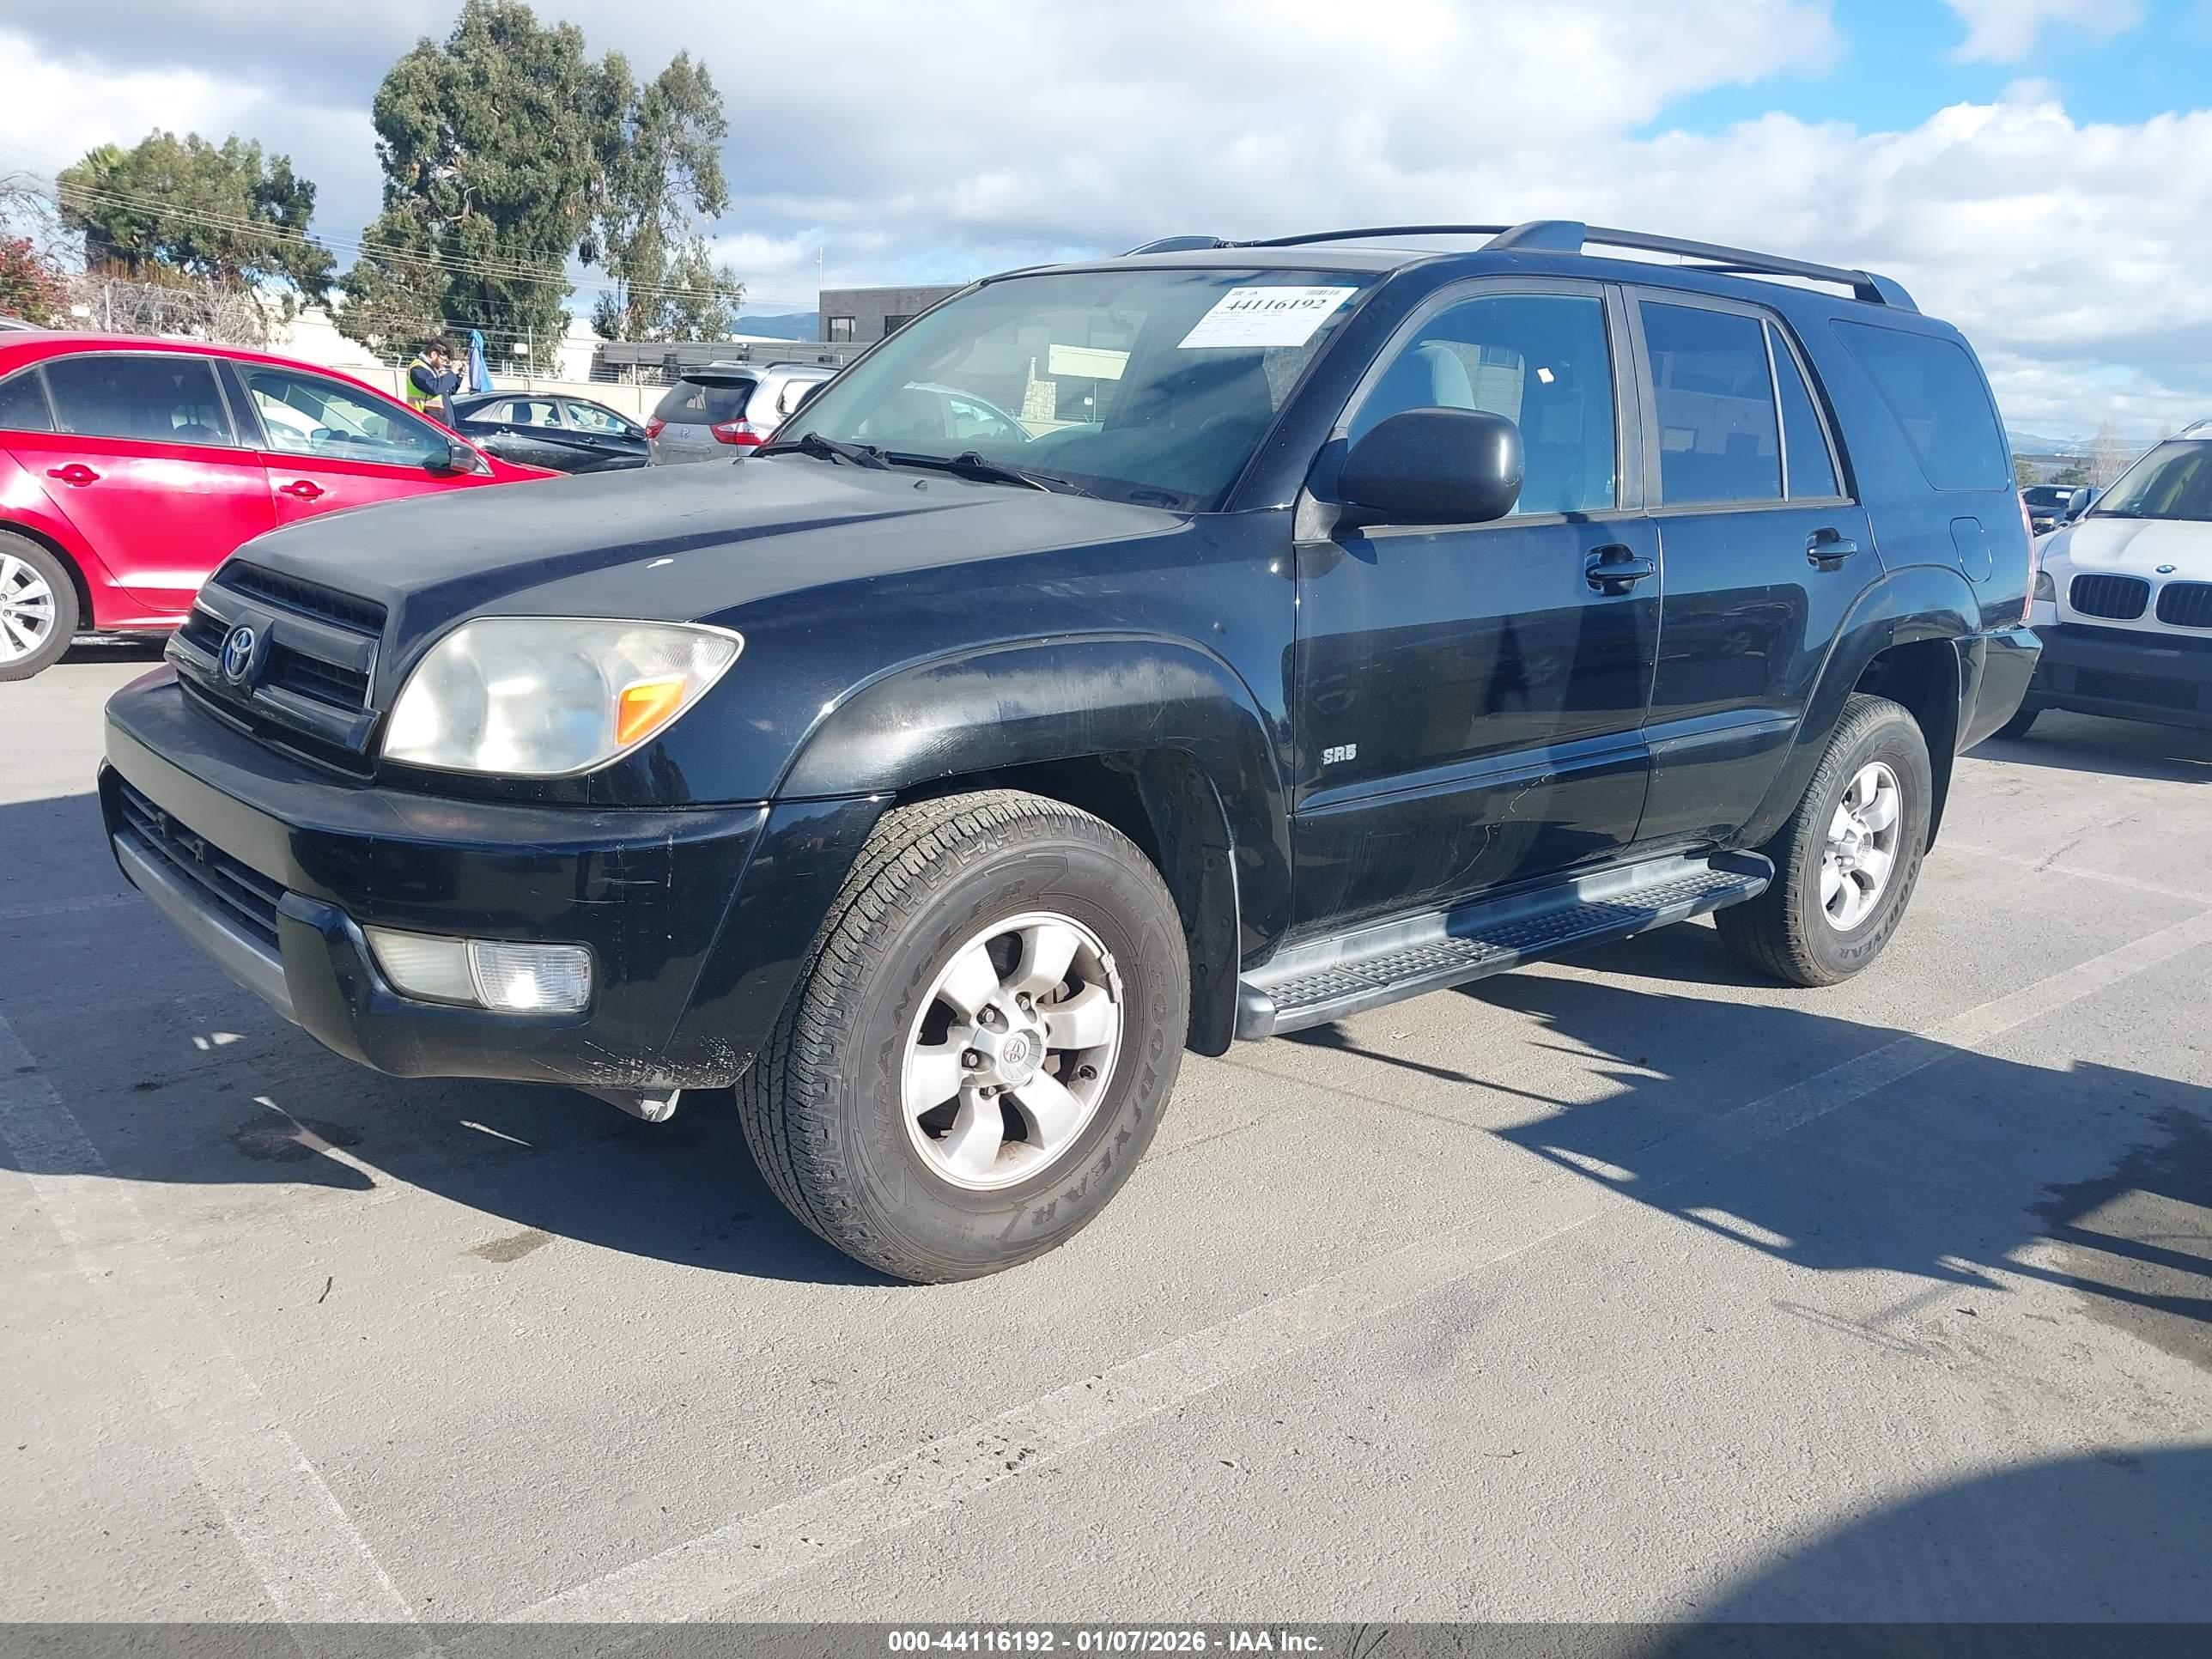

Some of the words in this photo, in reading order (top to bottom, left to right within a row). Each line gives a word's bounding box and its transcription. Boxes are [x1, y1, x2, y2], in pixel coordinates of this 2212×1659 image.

[1225, 298, 1328, 311] 44116192
[1322, 744, 1357, 765] SR5
[1030, 958, 1170, 1227] GOODYEAR
